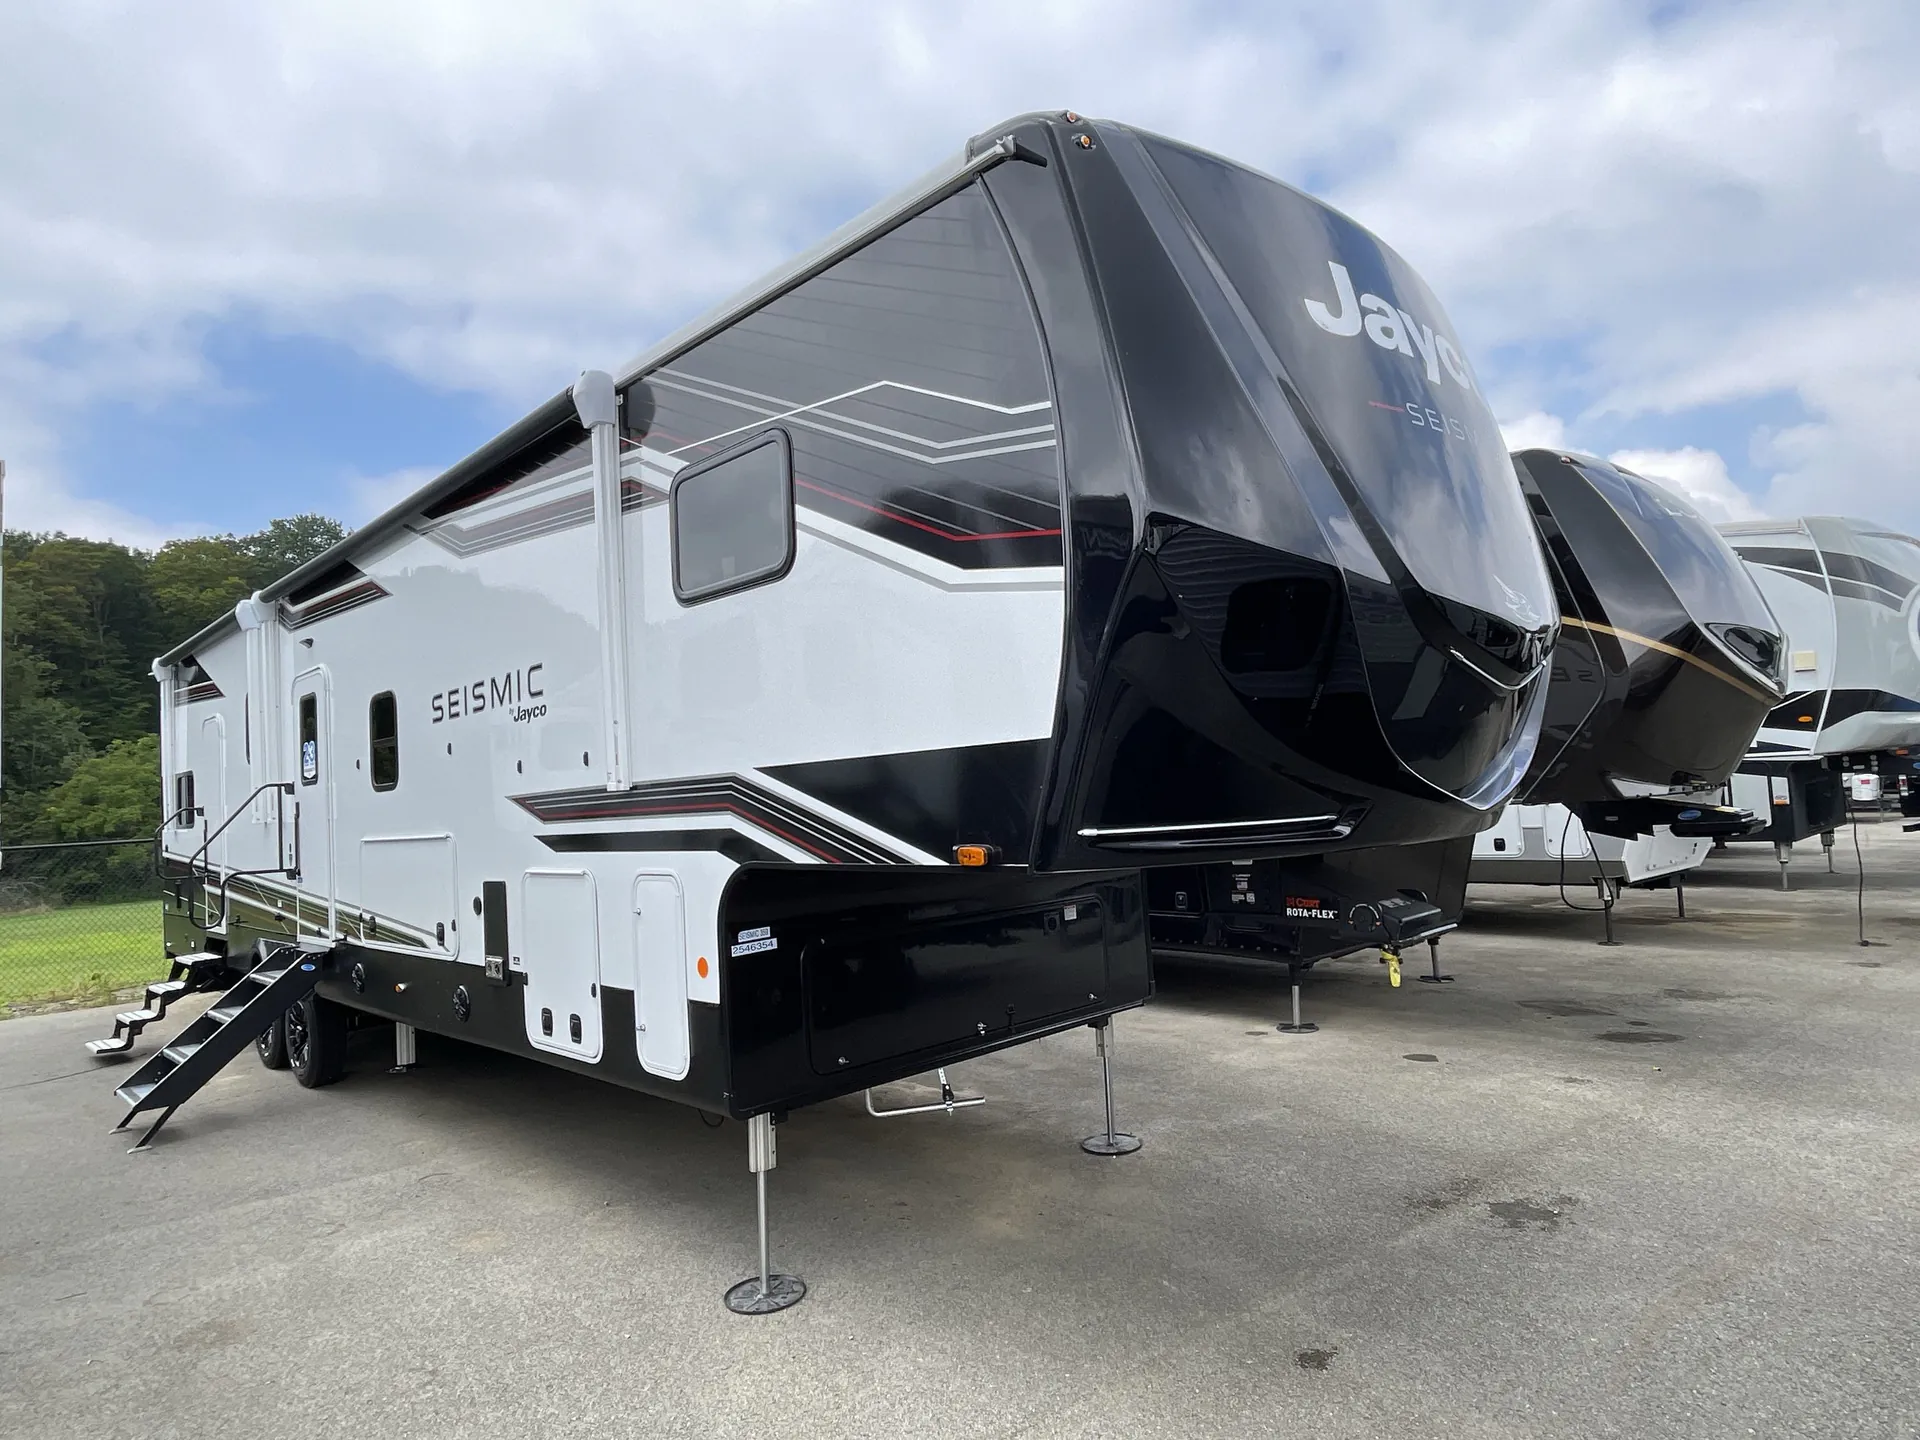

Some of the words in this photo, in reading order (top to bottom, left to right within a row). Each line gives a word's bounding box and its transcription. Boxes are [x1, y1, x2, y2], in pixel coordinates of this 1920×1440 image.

[1304, 261, 1481, 398] Jayc
[432, 663, 544, 724] SEISMIC
[514, 704, 547, 723] Jayco
[733, 940, 773, 954] 2546354
